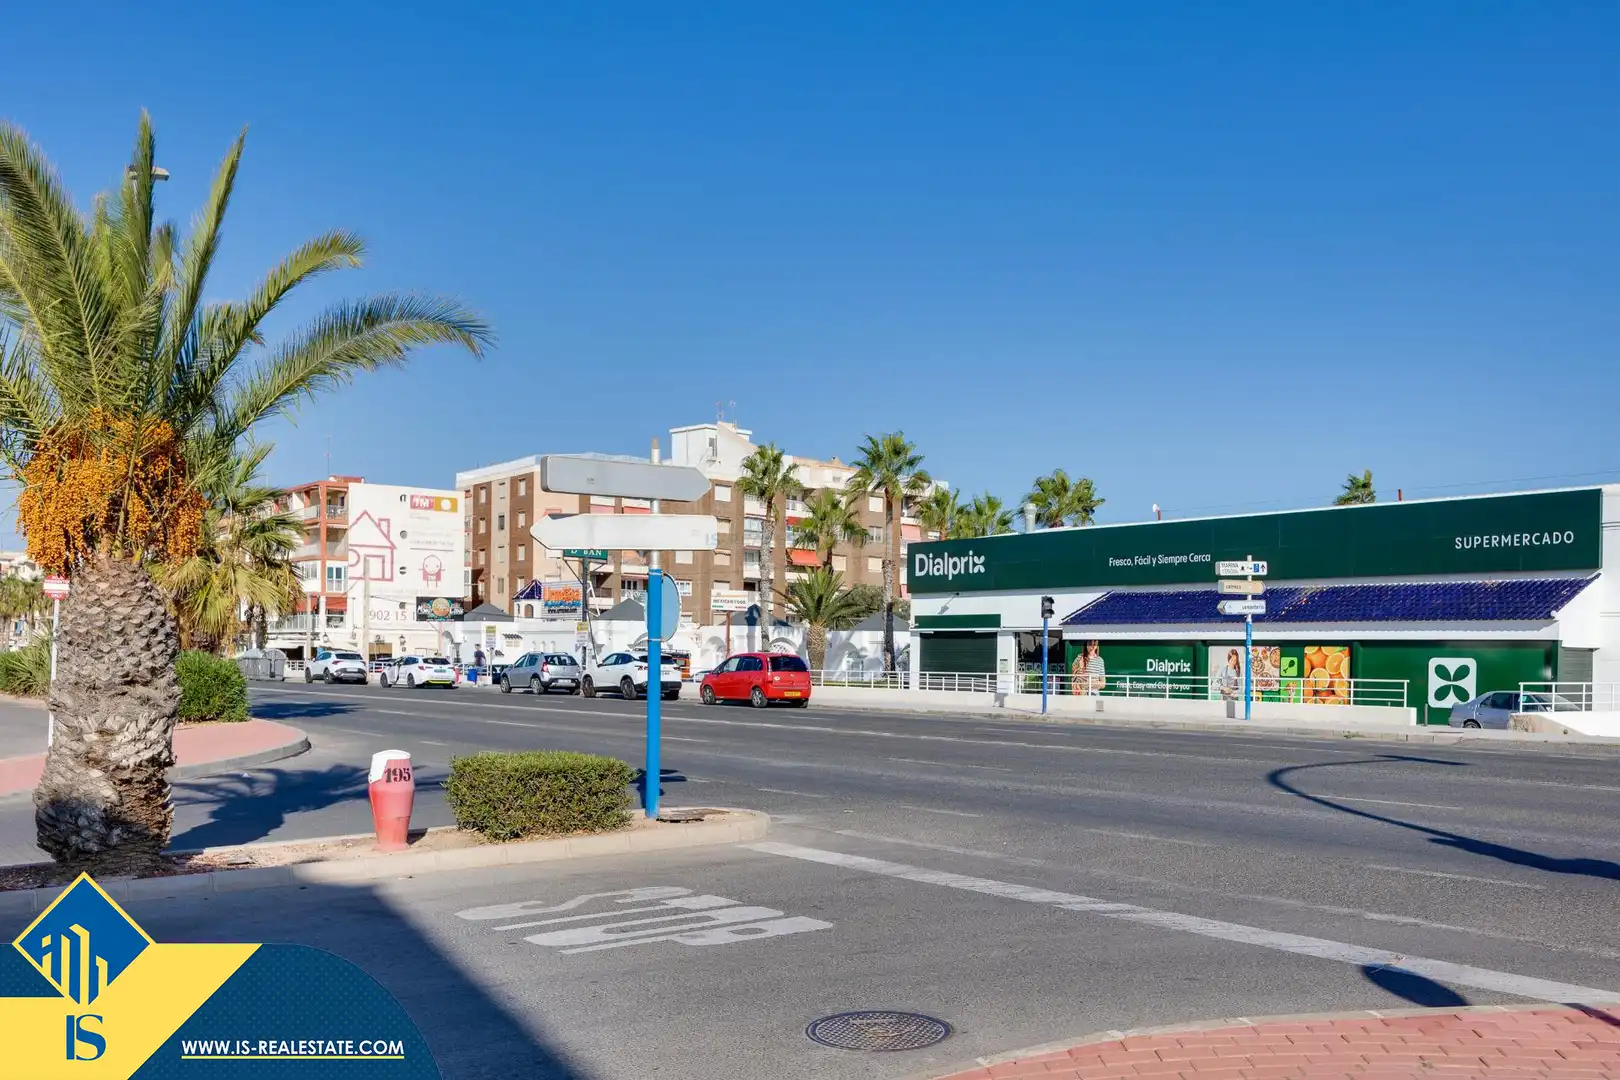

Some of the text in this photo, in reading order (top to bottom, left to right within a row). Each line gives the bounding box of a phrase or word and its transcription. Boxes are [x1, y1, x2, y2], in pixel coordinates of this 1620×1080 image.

[1454, 530, 1575, 550] SUPERMERCADO
[914, 550, 986, 581] Dialprix
[1108, 552, 1211, 568] Fresco, Fácil y Siempre Cerca
[369, 610, 391, 621] 902
[1146, 658, 1191, 675] Dialprix
[384, 767, 411, 783] 195
[454, 885, 834, 955] STOP
